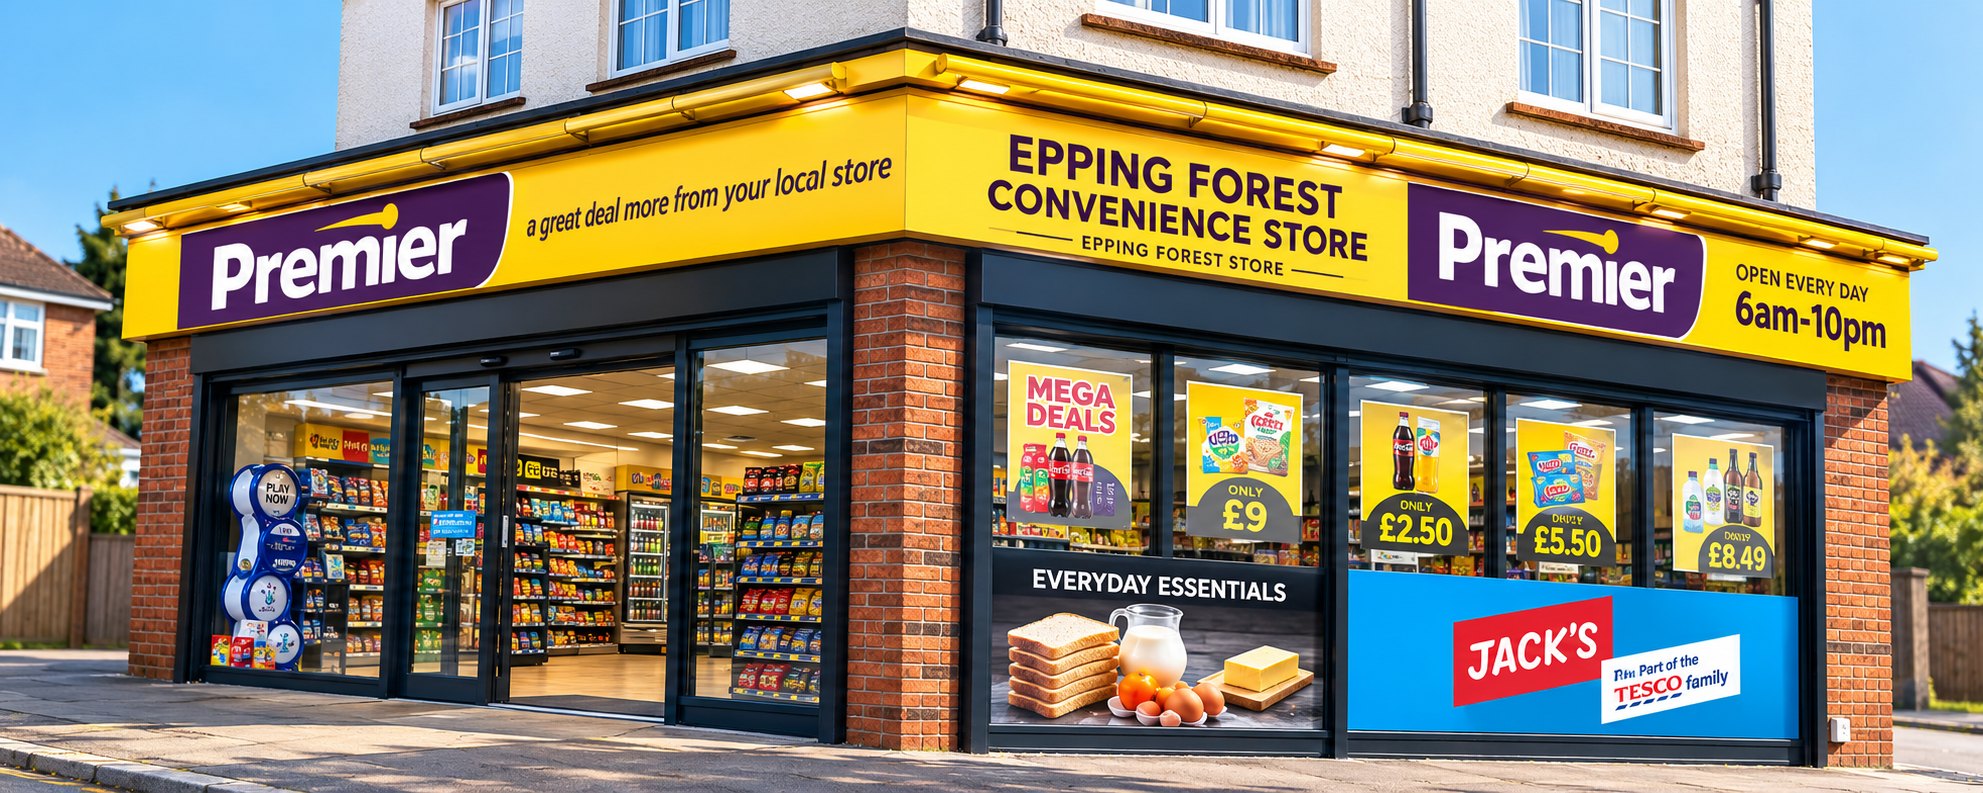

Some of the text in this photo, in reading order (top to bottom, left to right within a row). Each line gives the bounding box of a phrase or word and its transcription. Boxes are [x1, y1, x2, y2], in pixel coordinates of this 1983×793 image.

[1009, 134, 1343, 219] EPPING FOREST
[526, 156, 893, 241] a great deal more from your local store
[988, 179, 1368, 262] CONVENIENCE STORE
[211, 206, 468, 311] Premier
[1081, 235, 1284, 277] EPPING FOREST STORE
[1438, 212, 1676, 314] Premier
[1736, 263, 1869, 303] OPEN EVERY DAY
[1735, 290, 1886, 351] 6am-10pm
[1027, 375, 1116, 409] MEGA
[1026, 402, 1116, 435] DEALS
[265, 494, 289, 505] NOW
[266, 482, 290, 494] PLAY
[1228, 485, 1263, 498] ONLY
[1222, 498, 1267, 533] £9
[1379, 512, 1453, 547] £2.50
[1534, 525, 1601, 558] £5.50
[1708, 541, 1766, 572] £8.49
[1032, 568, 1287, 602] EVERYDAY ESSENTIALS
[1467, 621, 1598, 681] JACK'S
[1639, 661, 1664, 676] Part
[1666, 657, 1678, 671] of
[1680, 654, 1699, 667] the
[1614, 669, 1728, 702] TESCO family
